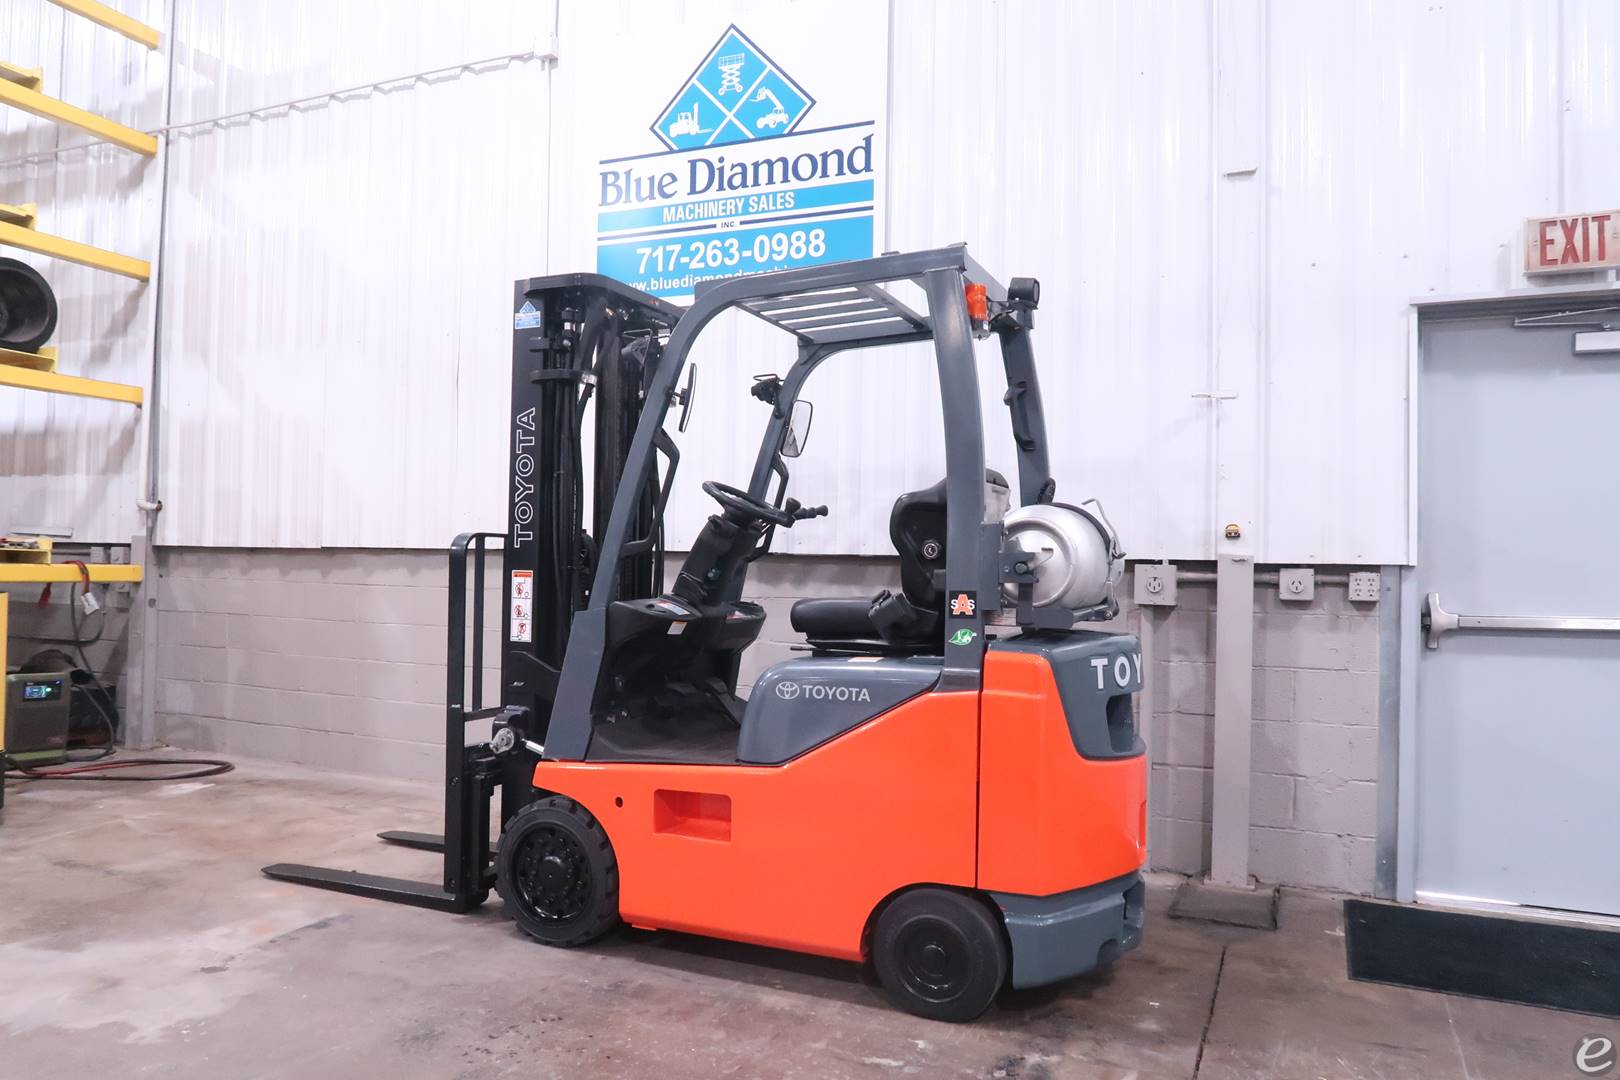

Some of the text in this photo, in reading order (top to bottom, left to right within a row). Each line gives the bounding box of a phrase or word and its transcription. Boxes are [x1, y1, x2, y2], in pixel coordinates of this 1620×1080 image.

[599, 133, 874, 206] Blue Diamond
[662, 191, 795, 223] MACHINERY SALES
[636, 228, 826, 274] 717-263-0988
[1539, 215, 1611, 267] EXIT
[514, 407, 536, 548] TOYOTA
[950, 593, 976, 616] SAS
[1090, 653, 1142, 690] TOY
[802, 685, 871, 702] TOYOTA
